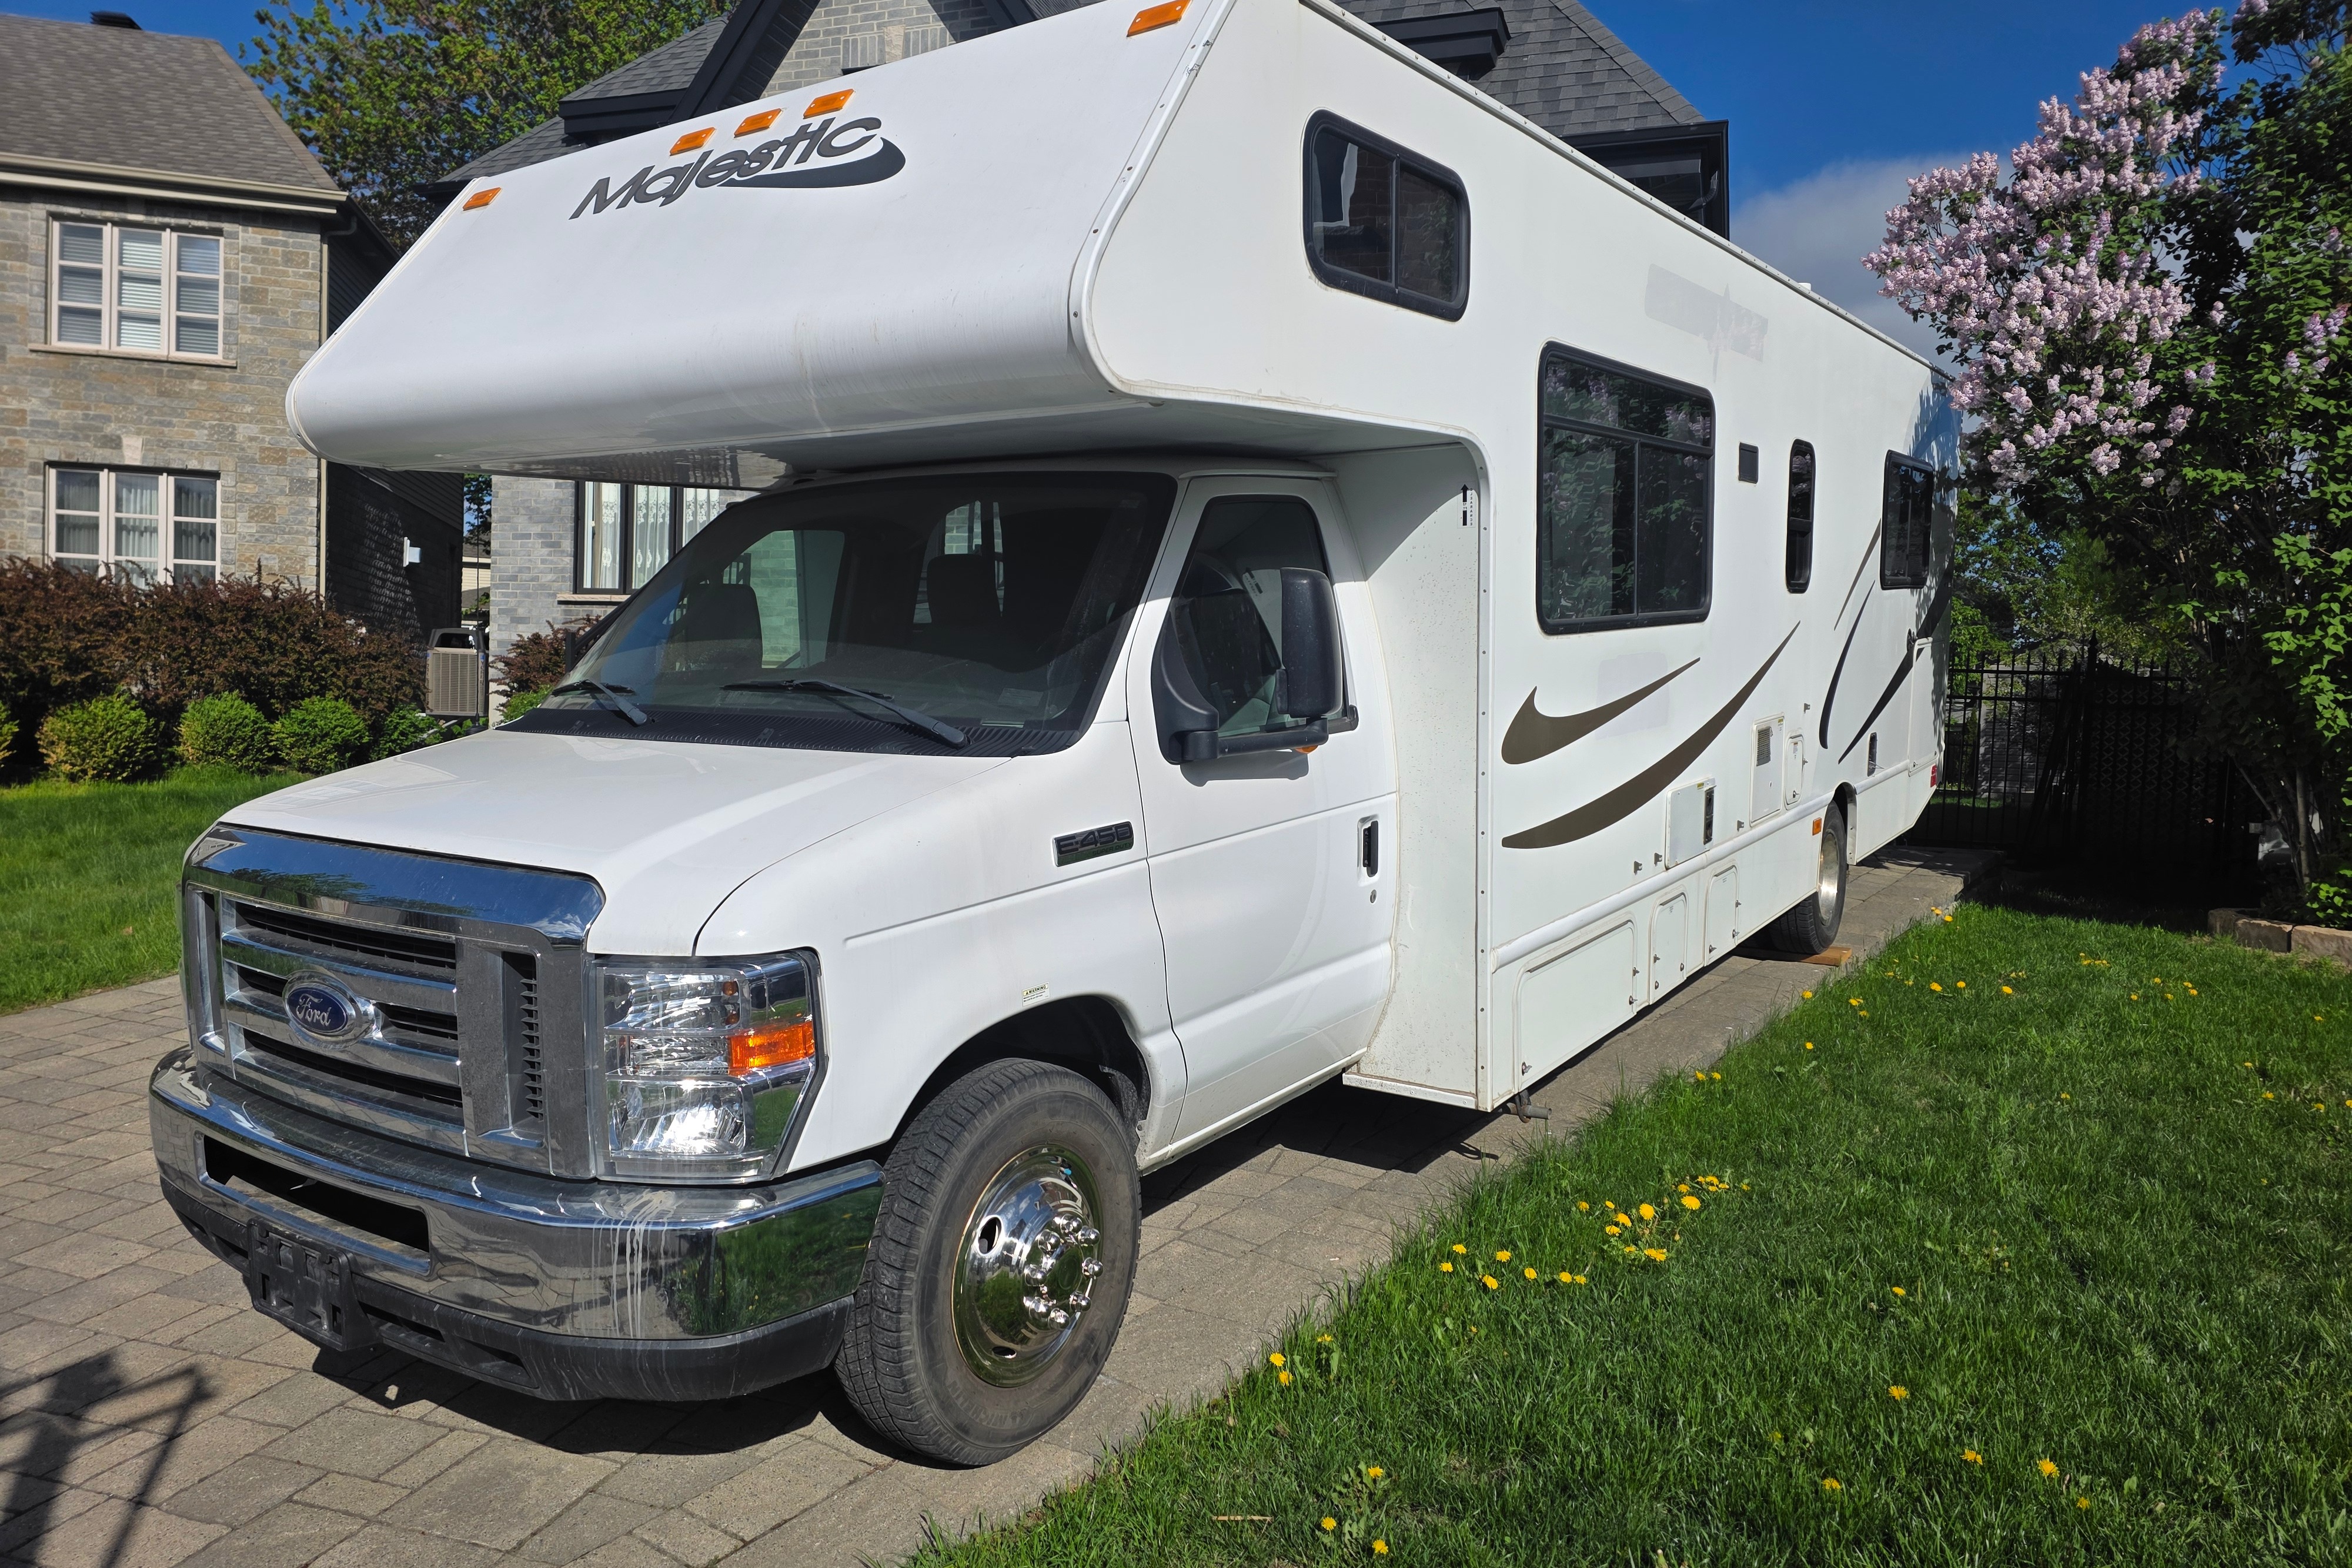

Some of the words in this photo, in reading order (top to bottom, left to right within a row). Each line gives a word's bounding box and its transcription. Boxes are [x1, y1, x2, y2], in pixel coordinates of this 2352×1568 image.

[1093, 846, 1114, 856] SUPER
[1115, 841, 1132, 850] DUTY
[1029, 985, 1046, 994] WARNING
[296, 994, 332, 1027] Ford
